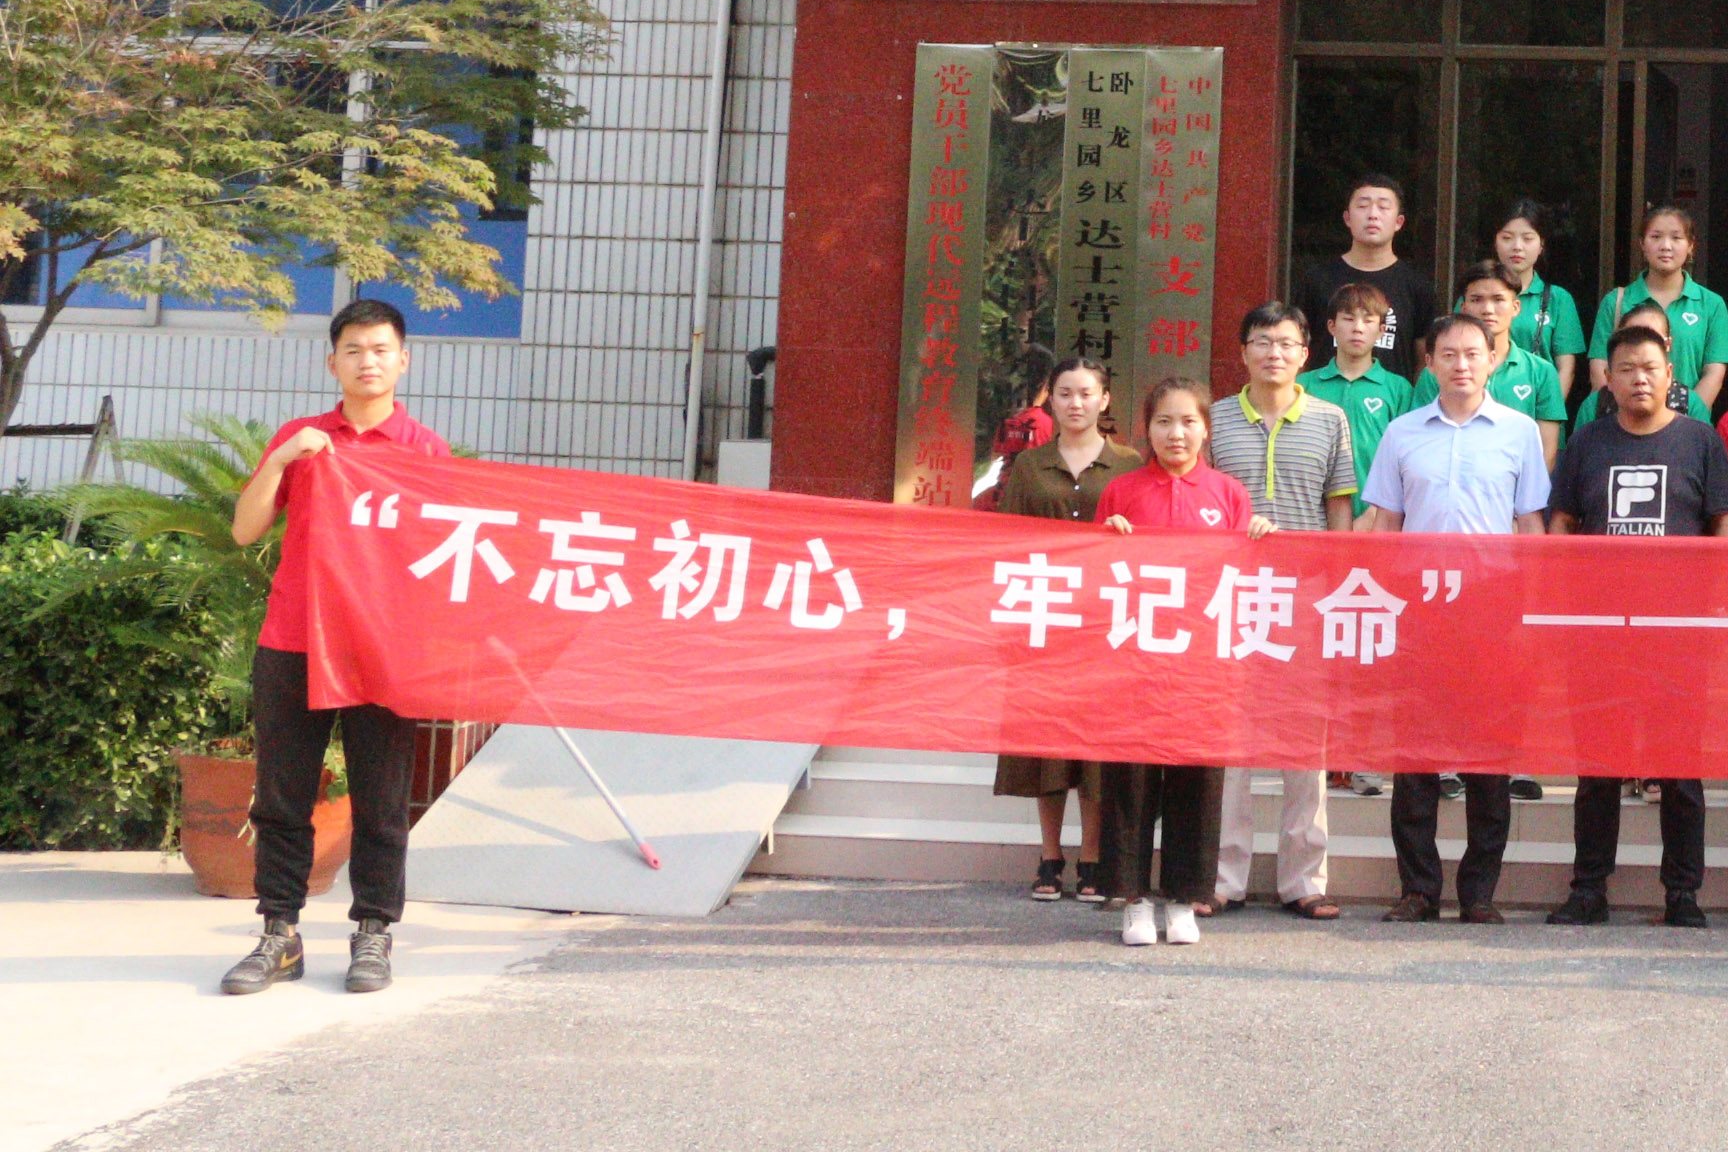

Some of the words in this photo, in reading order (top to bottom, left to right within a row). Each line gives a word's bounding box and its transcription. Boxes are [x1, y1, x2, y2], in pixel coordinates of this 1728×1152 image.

[1075, 70, 1105, 204] 七里园乡
[1105, 70, 1134, 204] 卧龙区
[1149, 75, 1179, 241] 七里园乡达士营村
[1183, 76, 1212, 243] 中国共产党
[912, 64, 974, 506] 党员干部现代远程教育终端站
[1146, 255, 1202, 358] 支部
[1607, 523, 1665, 537] ITALIAN
